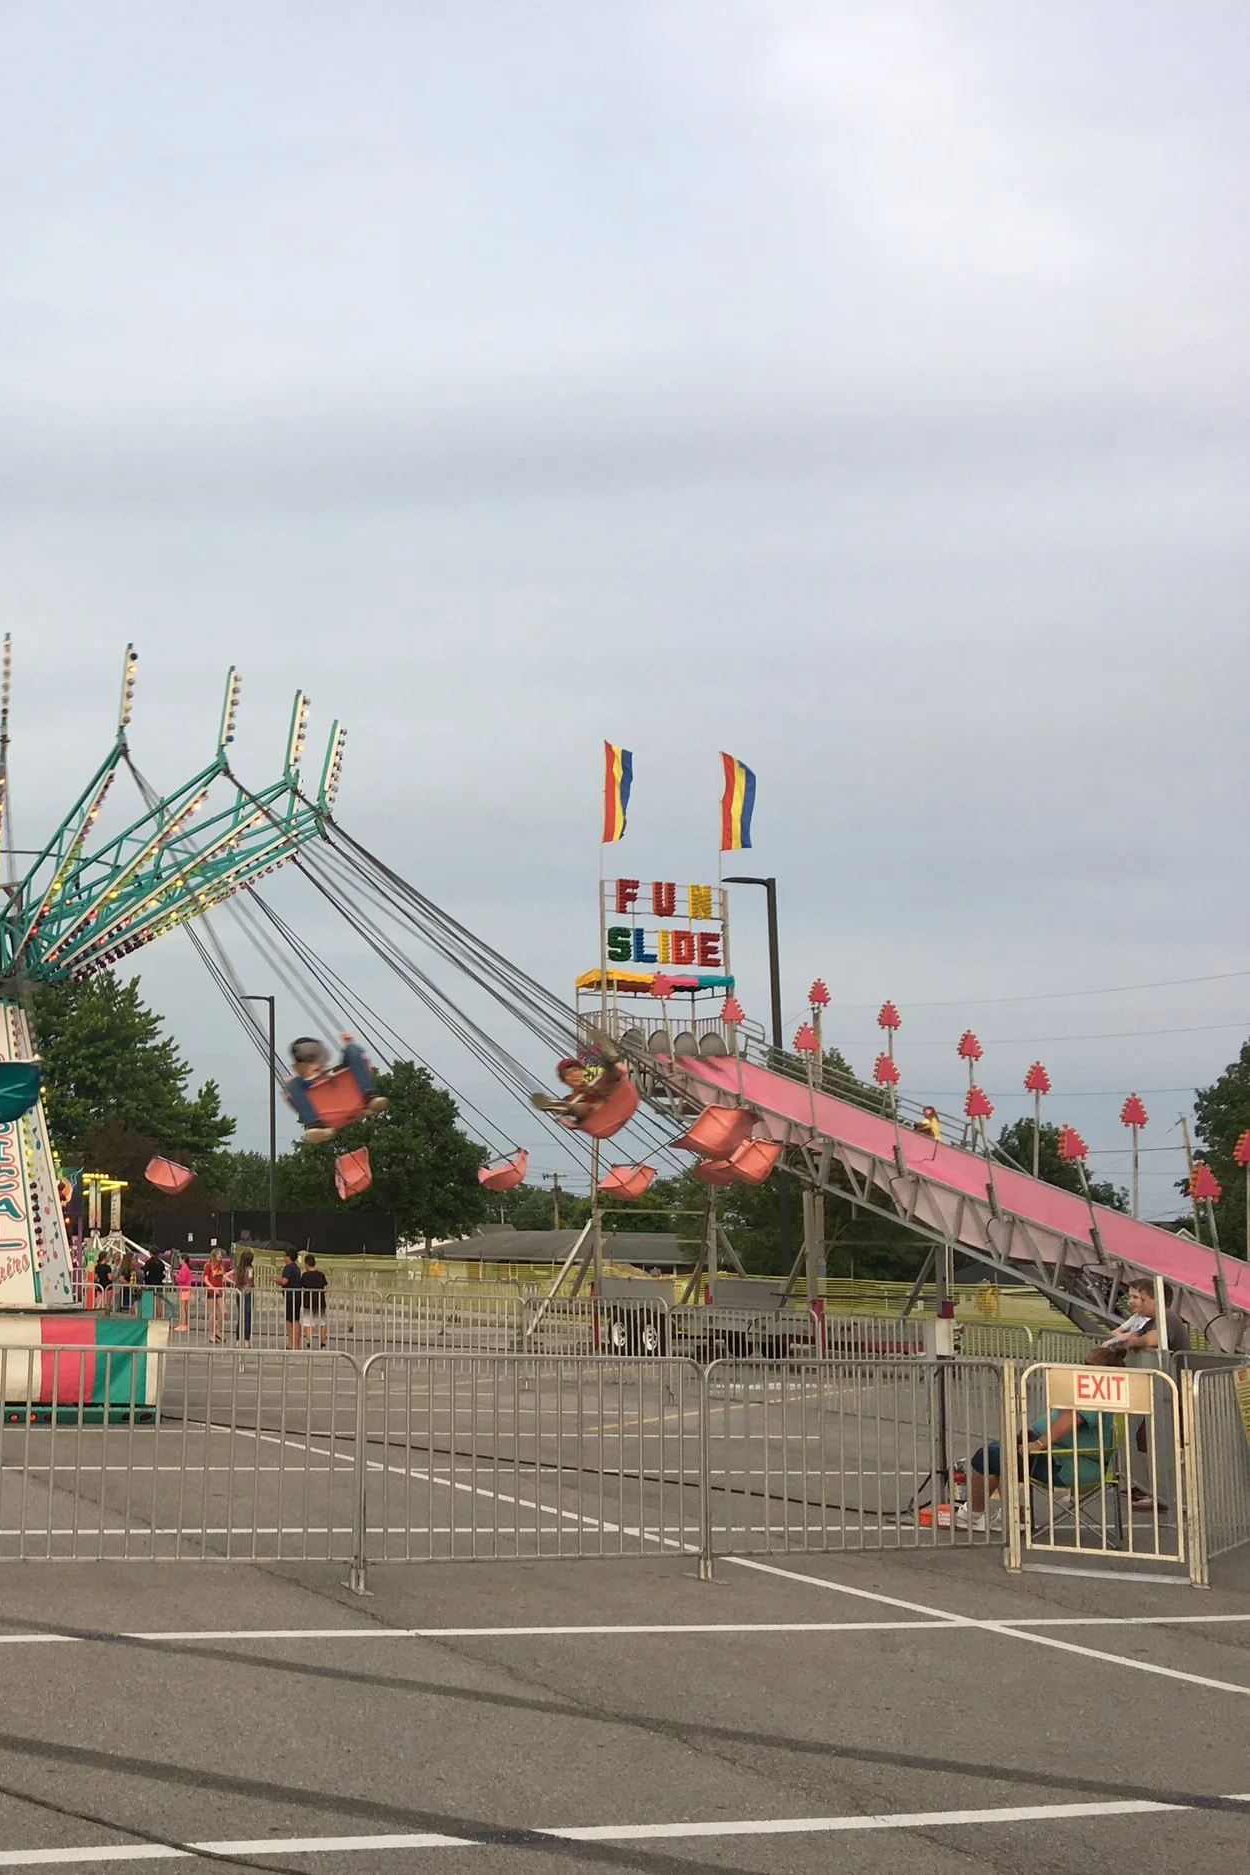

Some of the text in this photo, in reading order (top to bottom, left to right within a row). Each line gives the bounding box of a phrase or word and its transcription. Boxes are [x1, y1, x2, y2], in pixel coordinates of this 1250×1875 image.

[615, 878, 712, 919] FUN
[607, 926, 723, 967] SLIDE
[1076, 1374, 1125, 1401] EXIT
